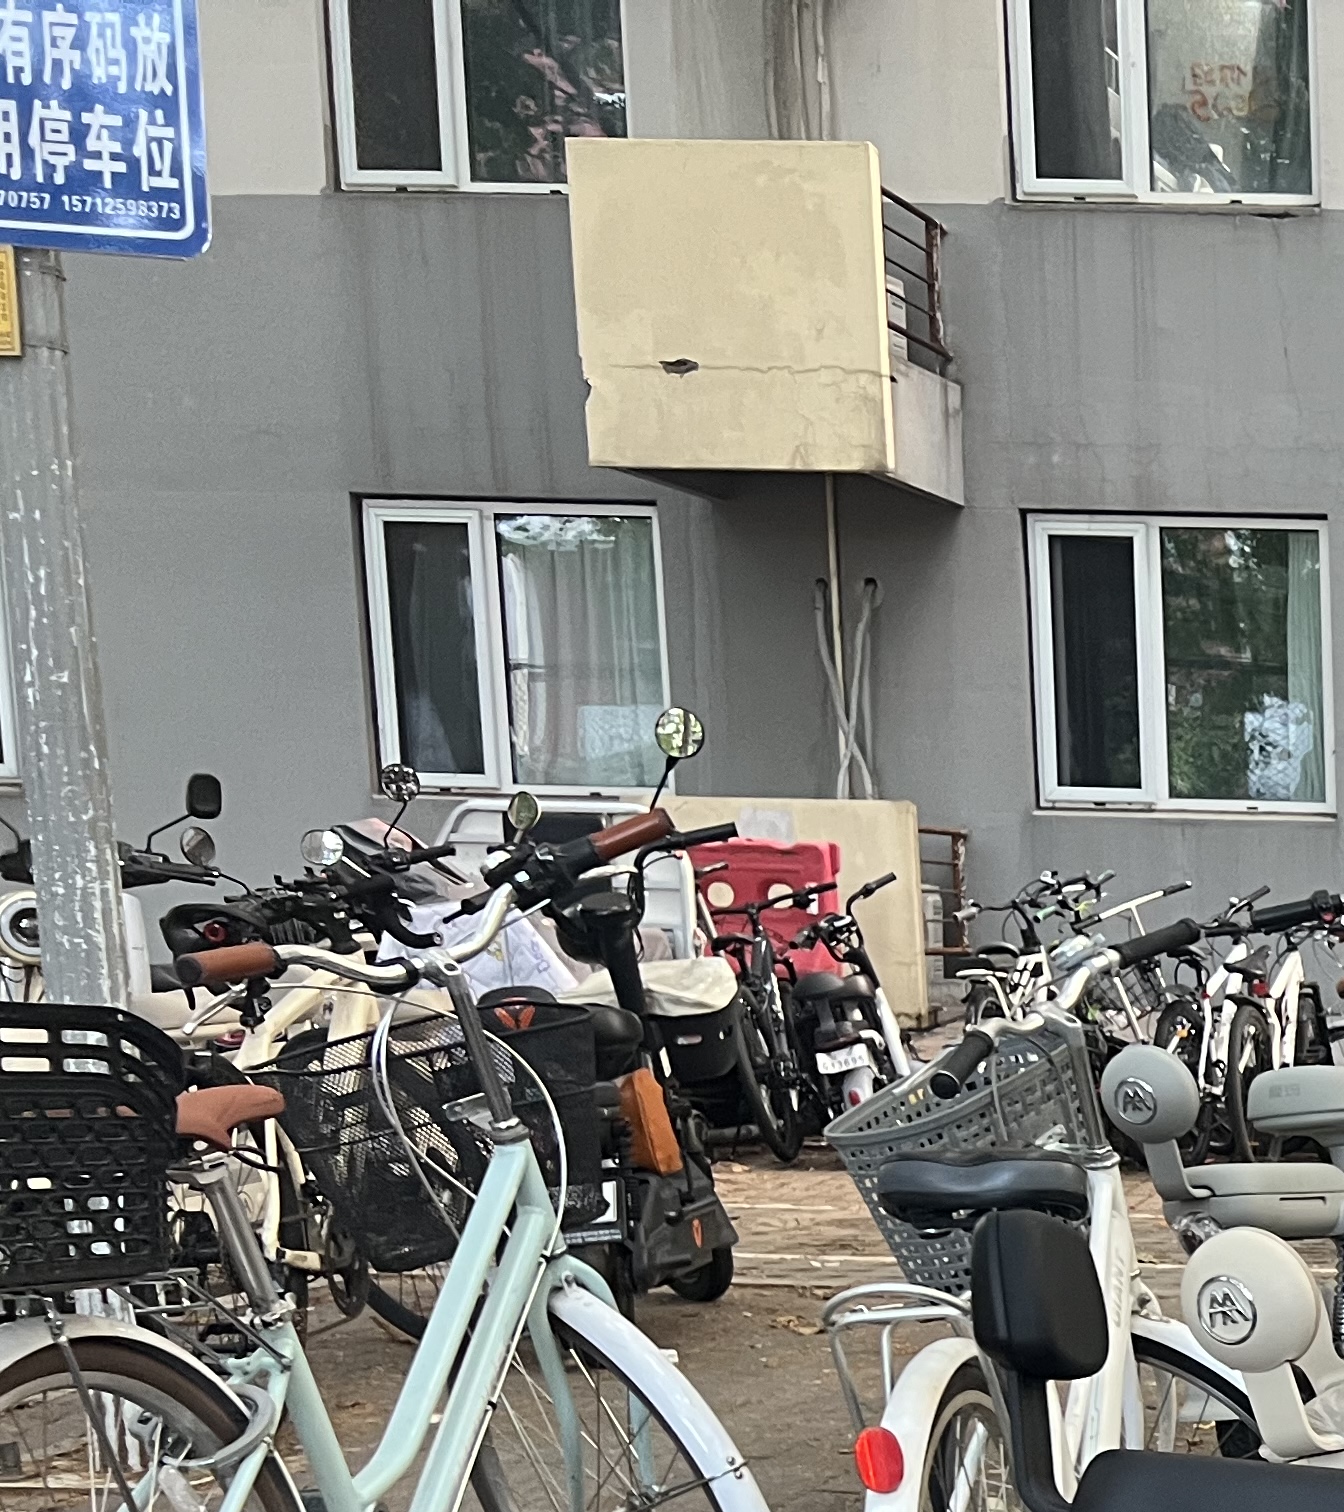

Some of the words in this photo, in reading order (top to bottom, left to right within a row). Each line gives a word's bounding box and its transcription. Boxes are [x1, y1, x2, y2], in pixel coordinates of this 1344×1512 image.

[0, 2, 173, 97] 有序码放
[62, 194, 181, 220] 15712598373
